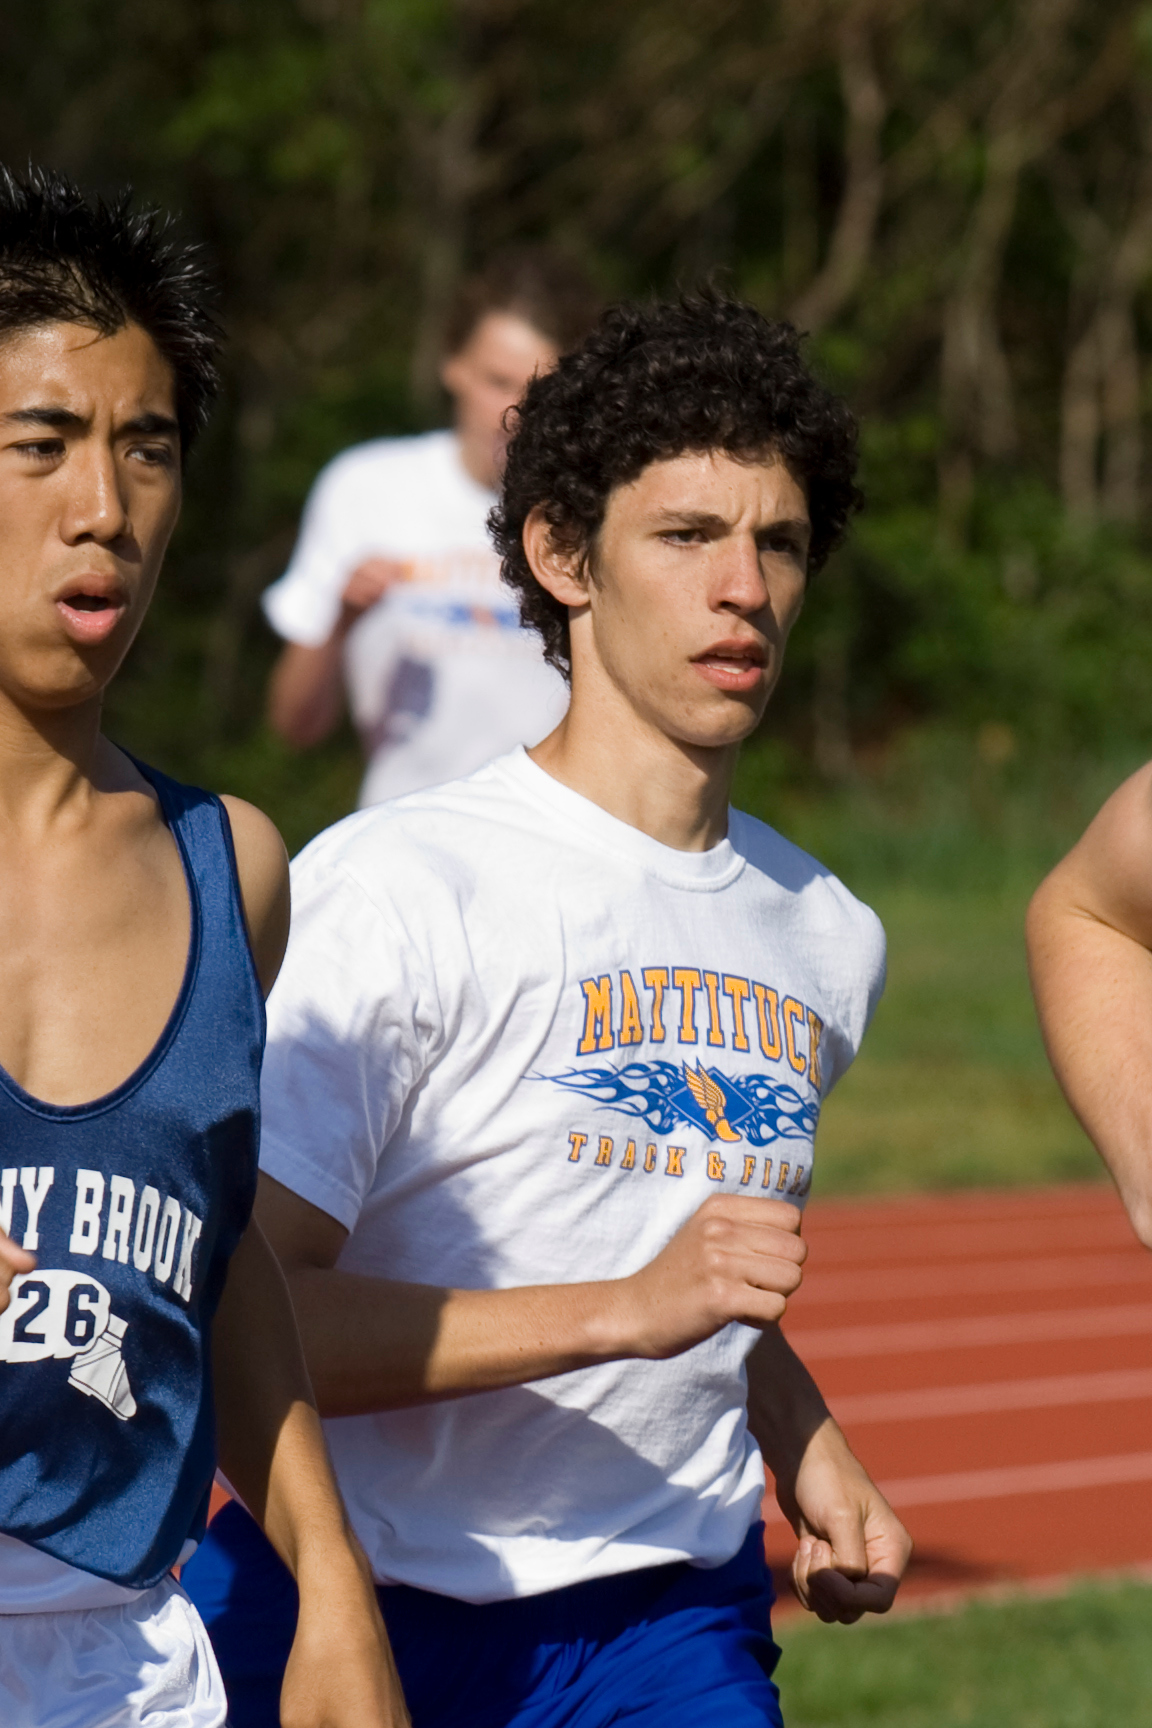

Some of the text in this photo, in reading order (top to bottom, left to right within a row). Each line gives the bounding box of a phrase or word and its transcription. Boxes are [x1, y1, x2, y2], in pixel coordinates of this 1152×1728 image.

[568, 1131, 812, 1197] TRACK & FIEL
[68, 1168, 203, 1303] BROOK
[12, 1280, 100, 1347] 26
